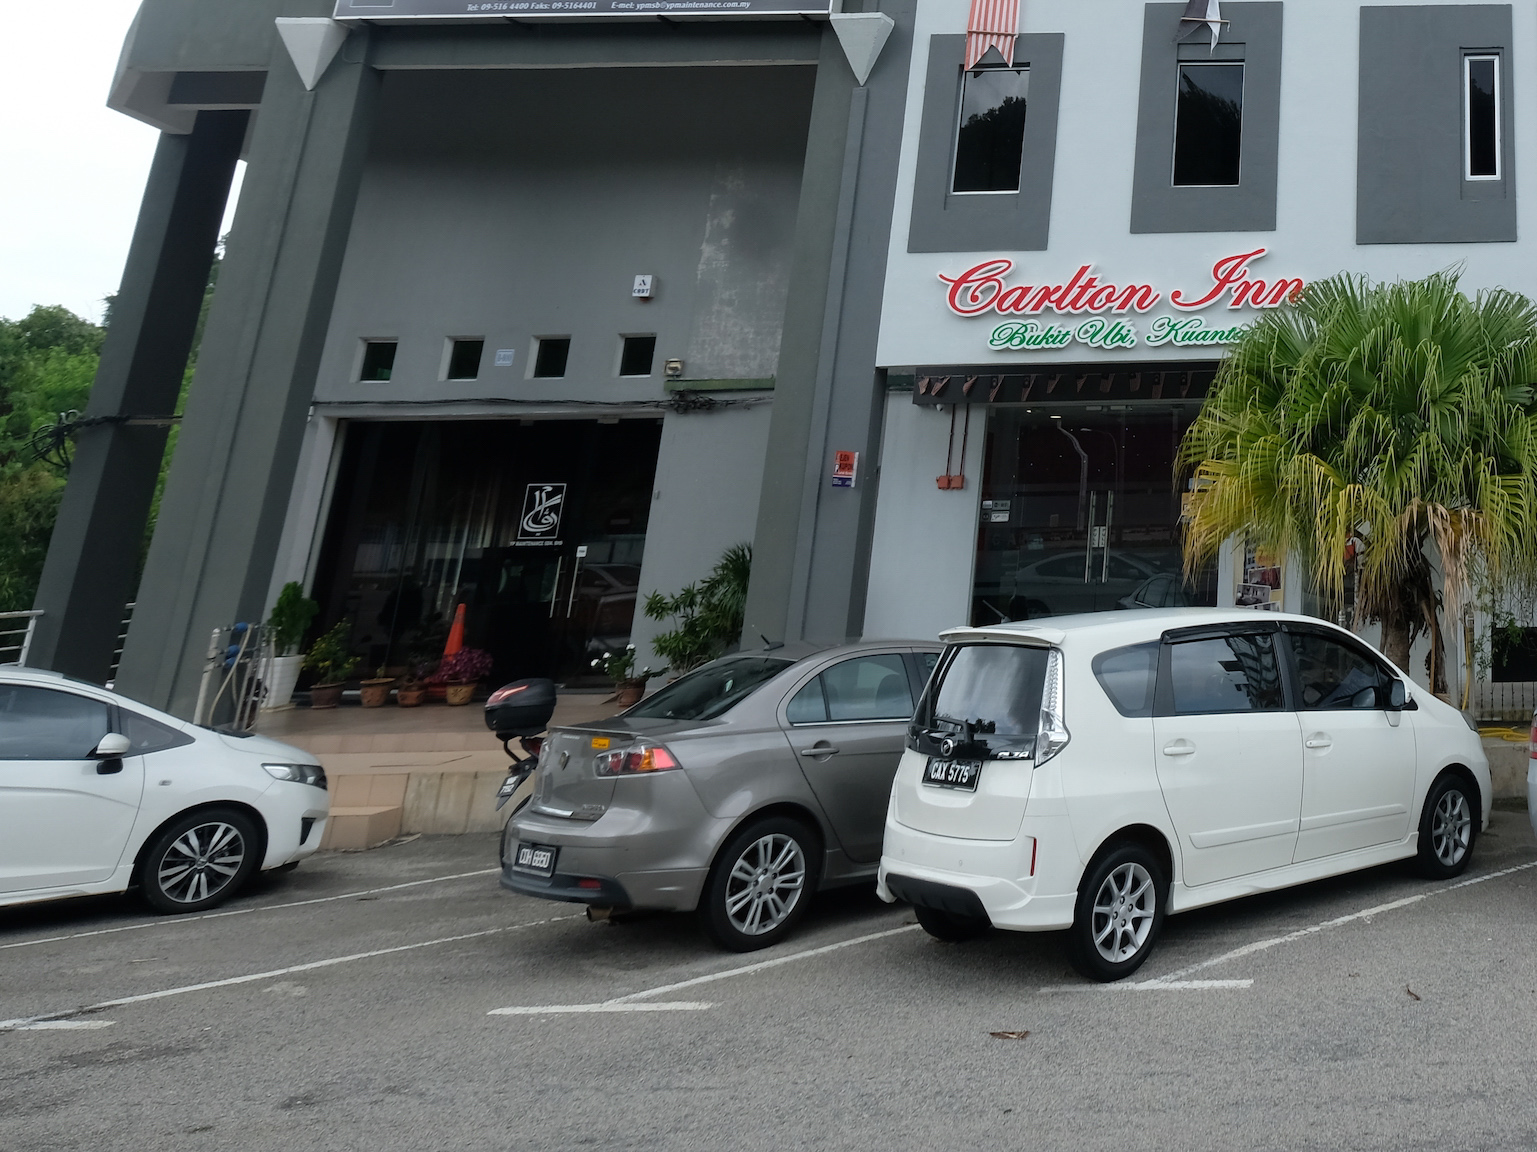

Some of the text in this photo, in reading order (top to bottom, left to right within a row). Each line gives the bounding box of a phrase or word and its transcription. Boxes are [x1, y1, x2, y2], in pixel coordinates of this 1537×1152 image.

[467, 3, 479, 11] Tel:
[611, 1, 635, 9] E-mel:
[635, 0, 751, 10] ypmsb@ypmaintenance.com.my
[939, 248, 1304, 314] Carlton Inn
[989, 321, 1070, 347] Bukit
[1077, 318, 1137, 347] Ubi,
[931, 761, 970, 783] CAX 5775
